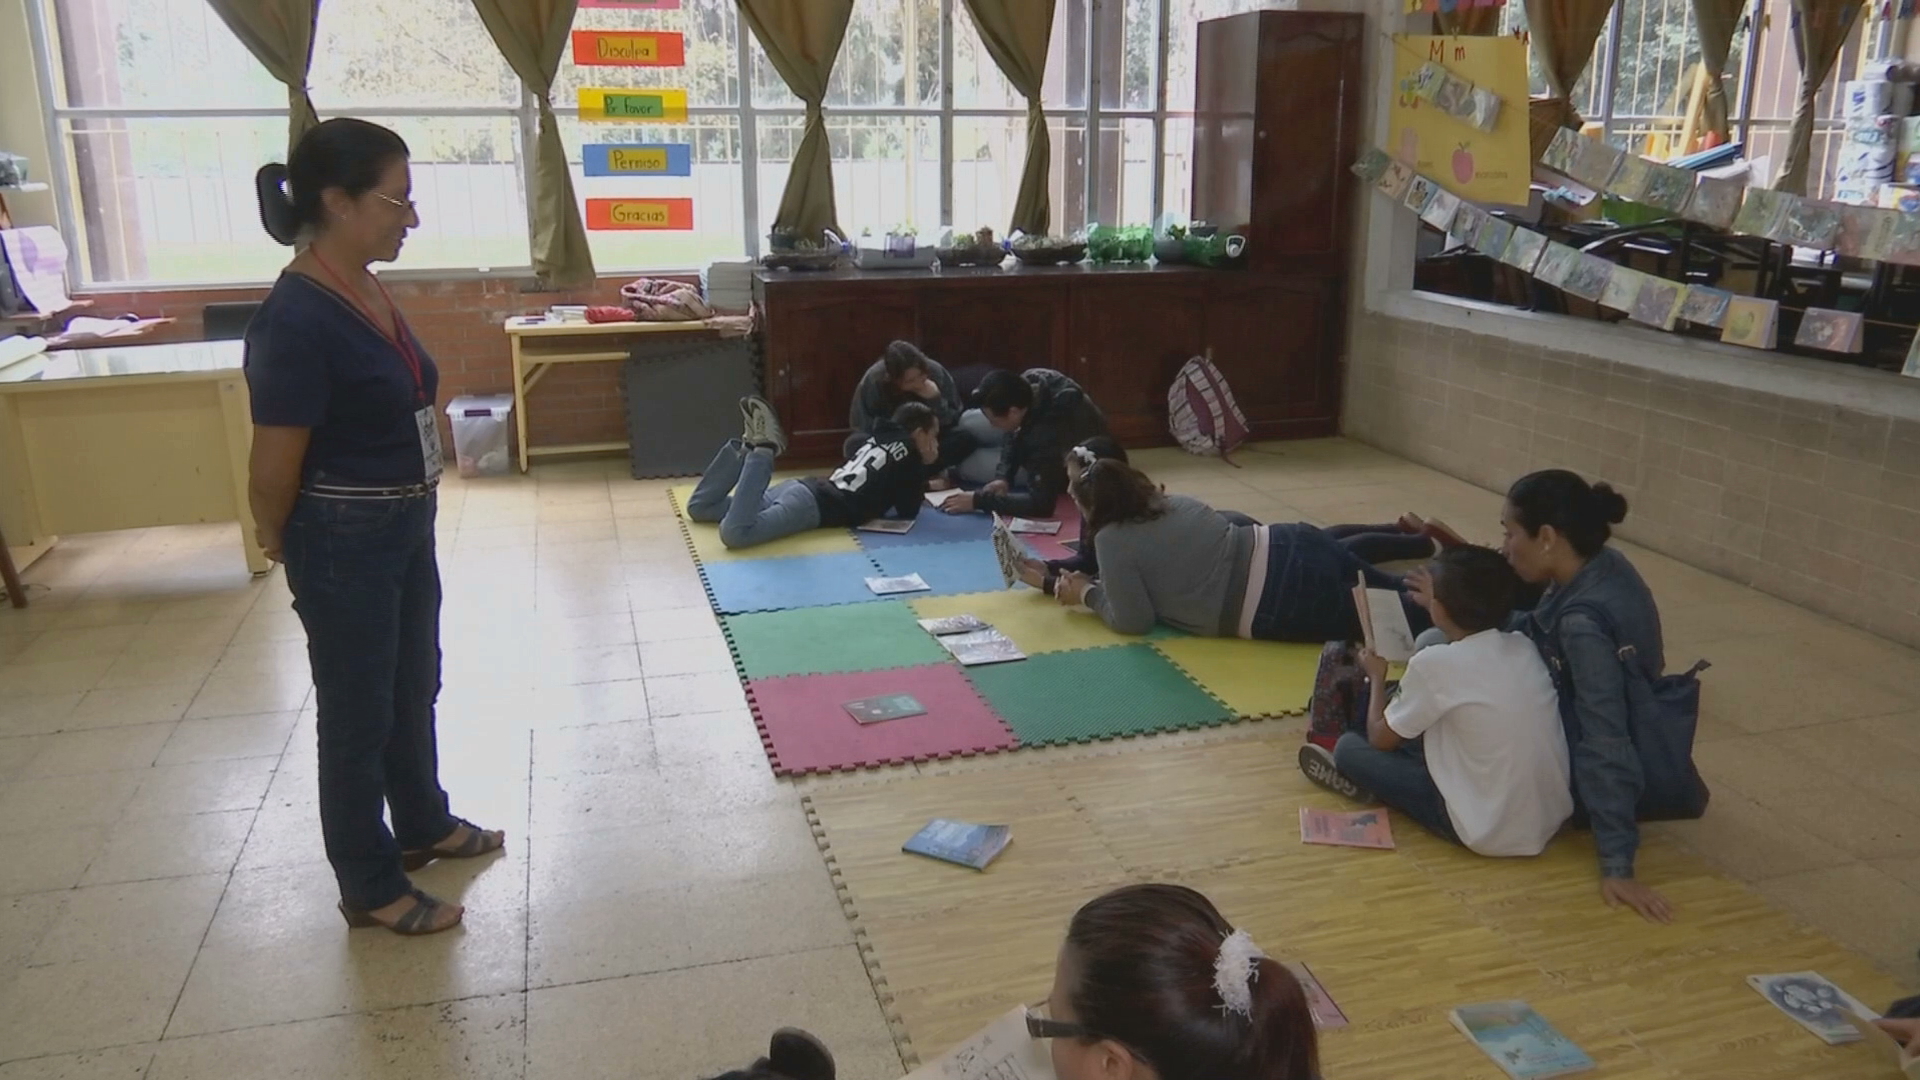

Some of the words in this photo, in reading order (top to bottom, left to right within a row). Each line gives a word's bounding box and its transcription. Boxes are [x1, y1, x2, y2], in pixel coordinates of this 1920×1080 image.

[597, 38, 650, 60] Disculpa
[1429, 40, 1444, 63] M
[1454, 46, 1466, 61] m
[613, 149, 660, 169] Permiso
[612, 204, 665, 222] Gracias
